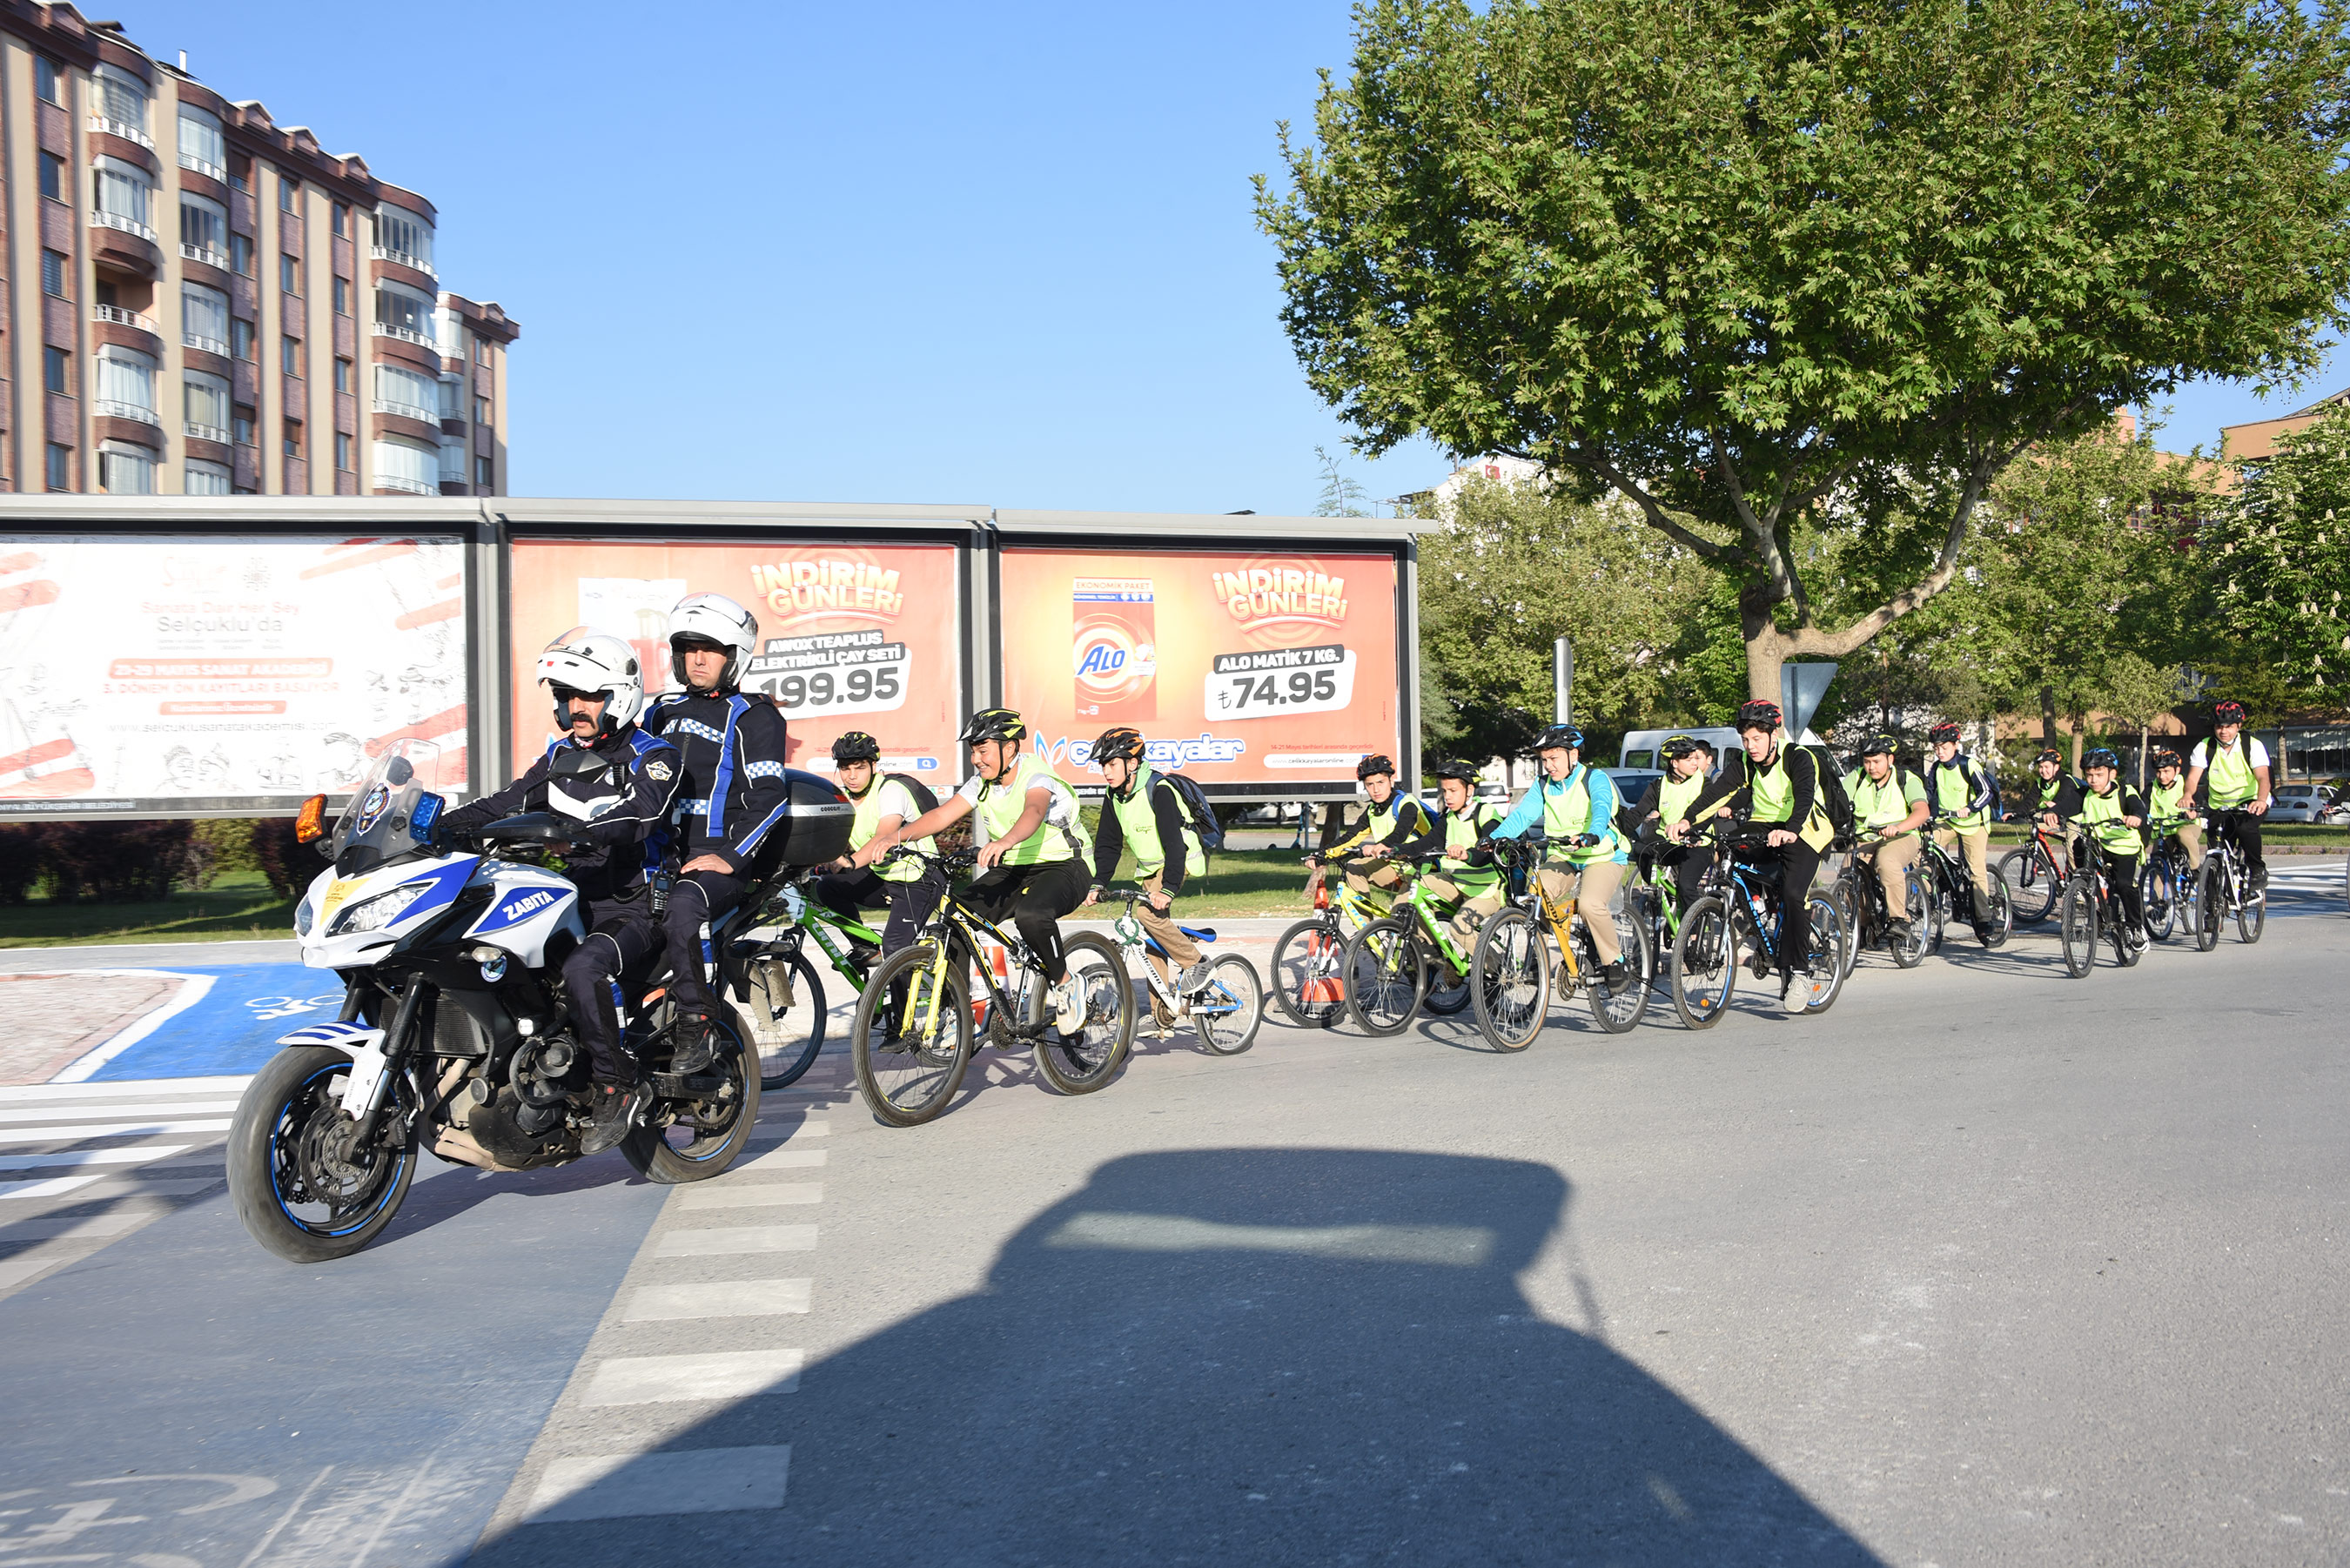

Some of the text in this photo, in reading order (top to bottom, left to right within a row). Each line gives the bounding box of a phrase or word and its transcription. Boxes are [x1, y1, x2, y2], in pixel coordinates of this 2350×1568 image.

[767, 581, 903, 616] GÜNLERİ
[1227, 588, 1348, 620] GÜNLERİ
[768, 632, 883, 653] AWOX TEAPLUS
[836, 650, 867, 667] ÇAY
[867, 645, 901, 661] SETİ
[1219, 656, 1252, 672] ALO
[1252, 649, 1302, 669] MATİK
[1302, 650, 1312, 664] 7
[760, 667, 899, 709] 199.95
[502, 890, 555, 921] ZABITA
